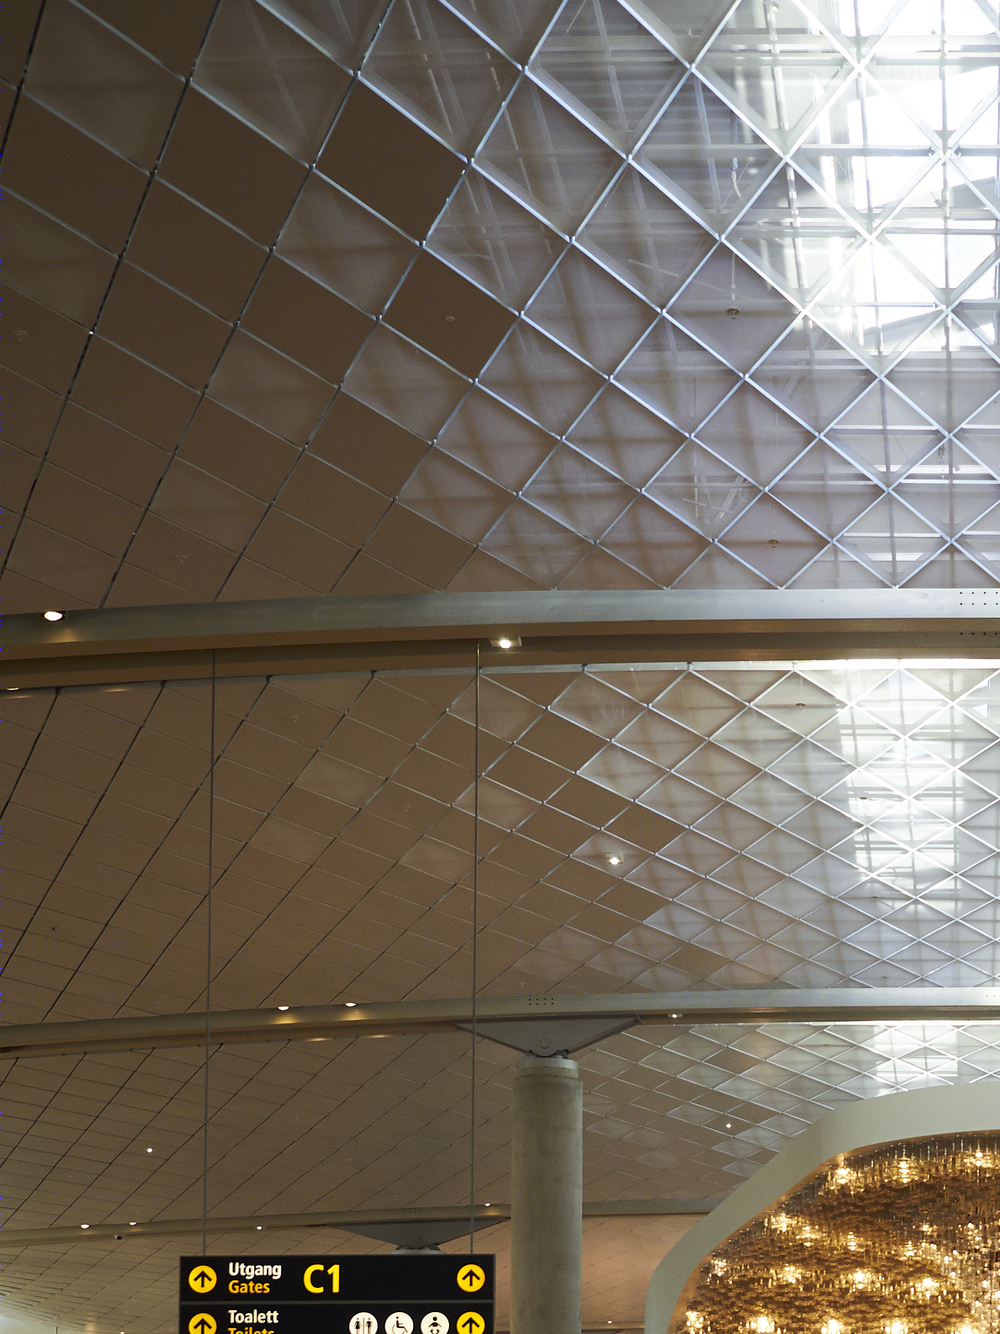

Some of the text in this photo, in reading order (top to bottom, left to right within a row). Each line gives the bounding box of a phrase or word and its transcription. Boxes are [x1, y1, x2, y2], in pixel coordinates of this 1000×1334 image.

[228, 1262, 340, 1294] Utgang C1
[228, 1279, 270, 1294] Gates
[228, 1309, 279, 1324] Toalett
